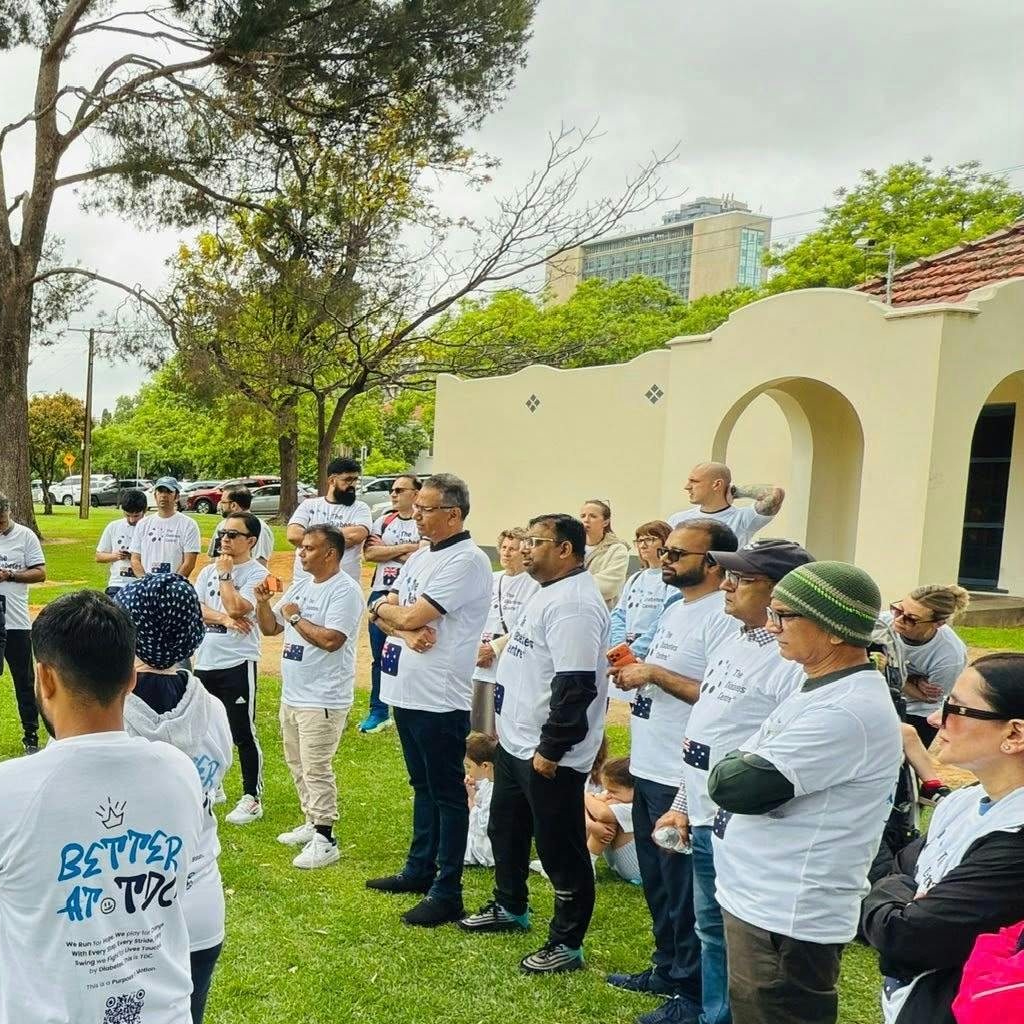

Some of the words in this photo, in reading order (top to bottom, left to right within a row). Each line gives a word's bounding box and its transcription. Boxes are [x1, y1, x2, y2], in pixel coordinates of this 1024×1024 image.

[58, 828, 182, 882] BETTER
[56, 886, 104, 921] AT
[114, 870, 177, 914] TDC
[78, 940, 92, 948] Run
[88, 949, 106, 958] Every
[75, 959, 96, 967] Swing
